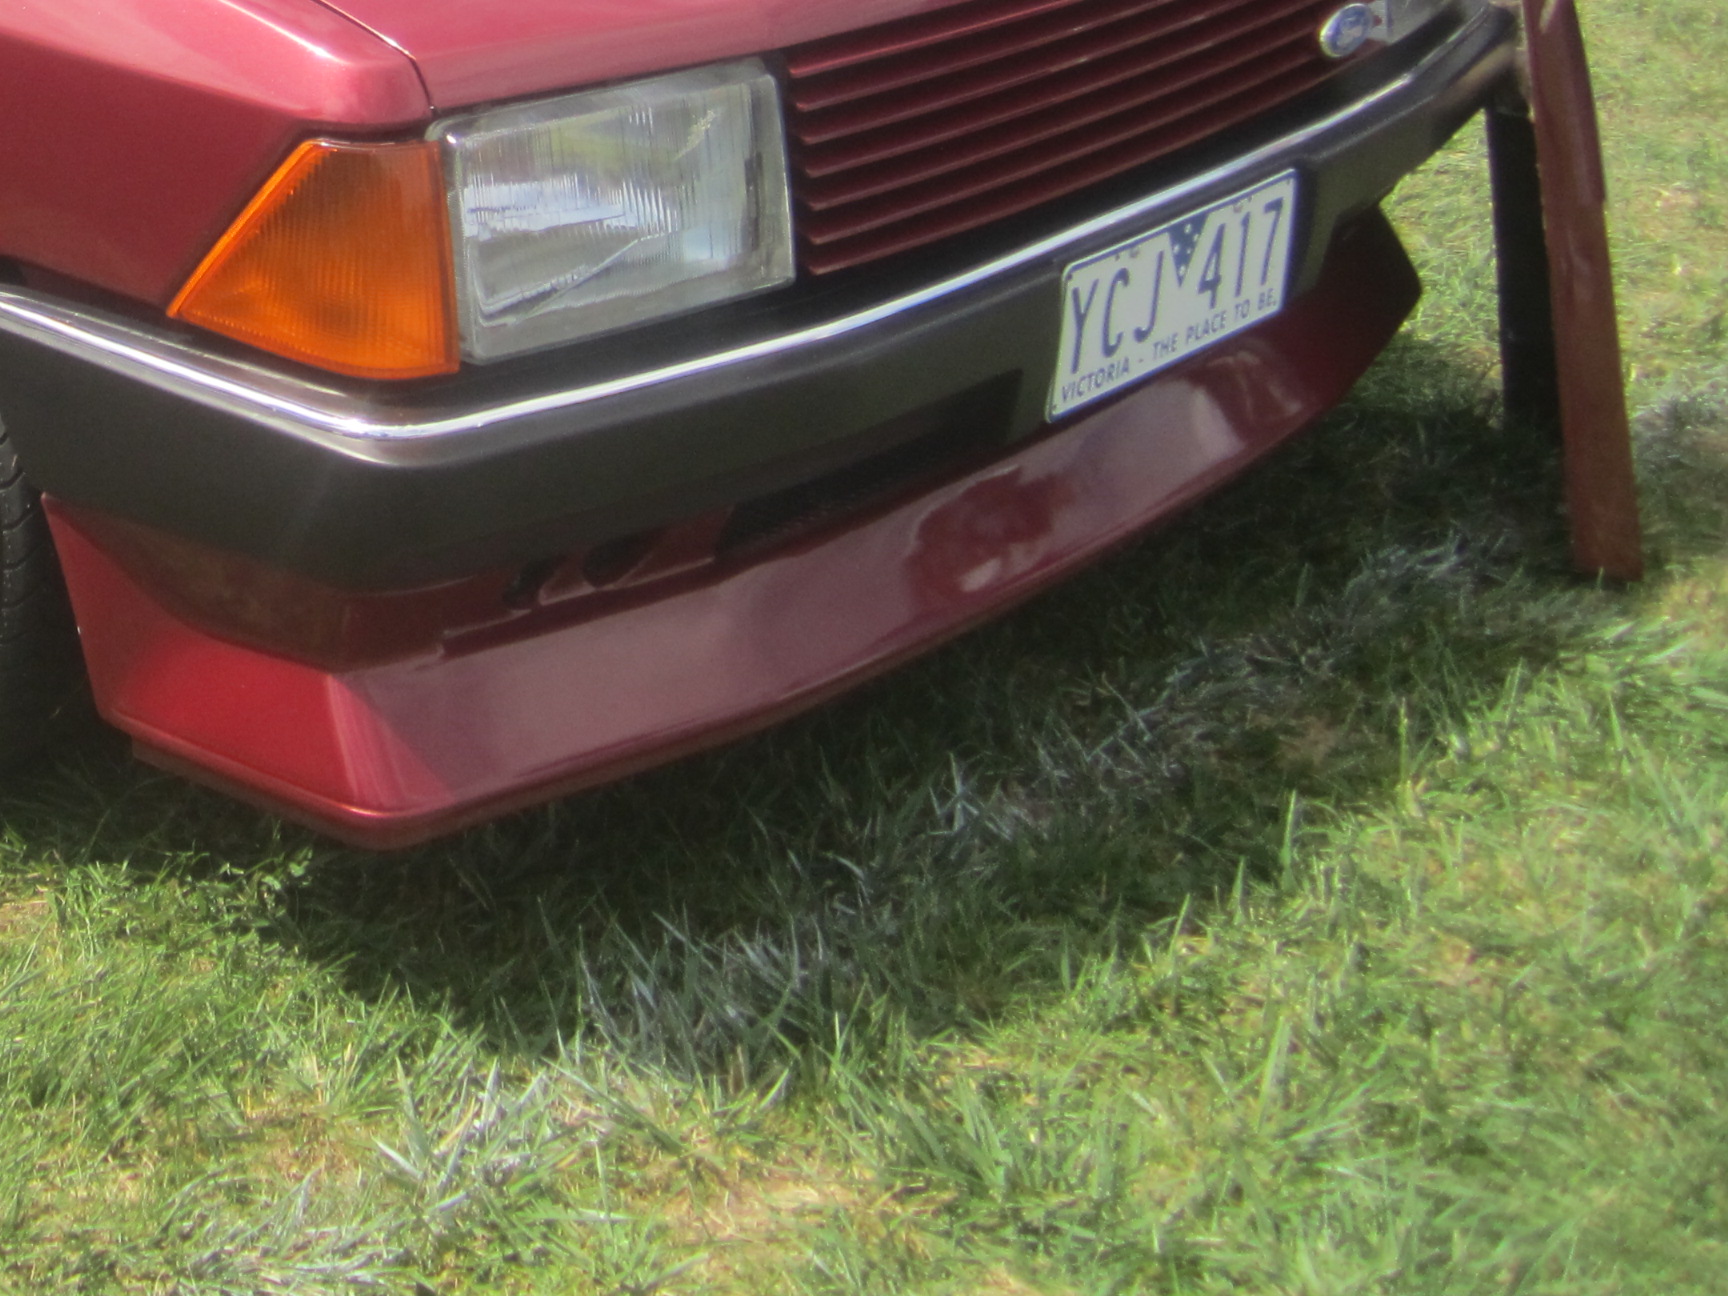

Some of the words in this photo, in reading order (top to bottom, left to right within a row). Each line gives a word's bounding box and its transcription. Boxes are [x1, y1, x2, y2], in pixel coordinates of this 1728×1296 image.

[1061, 357, 1130, 402] VICTORIA
[1152, 333, 1178, 361] THE
[1186, 310, 1228, 343] PLACE
[1233, 299, 1252, 321] TO
[1072, 250, 1165, 375] YCJ
[1197, 197, 1284, 309] 417
